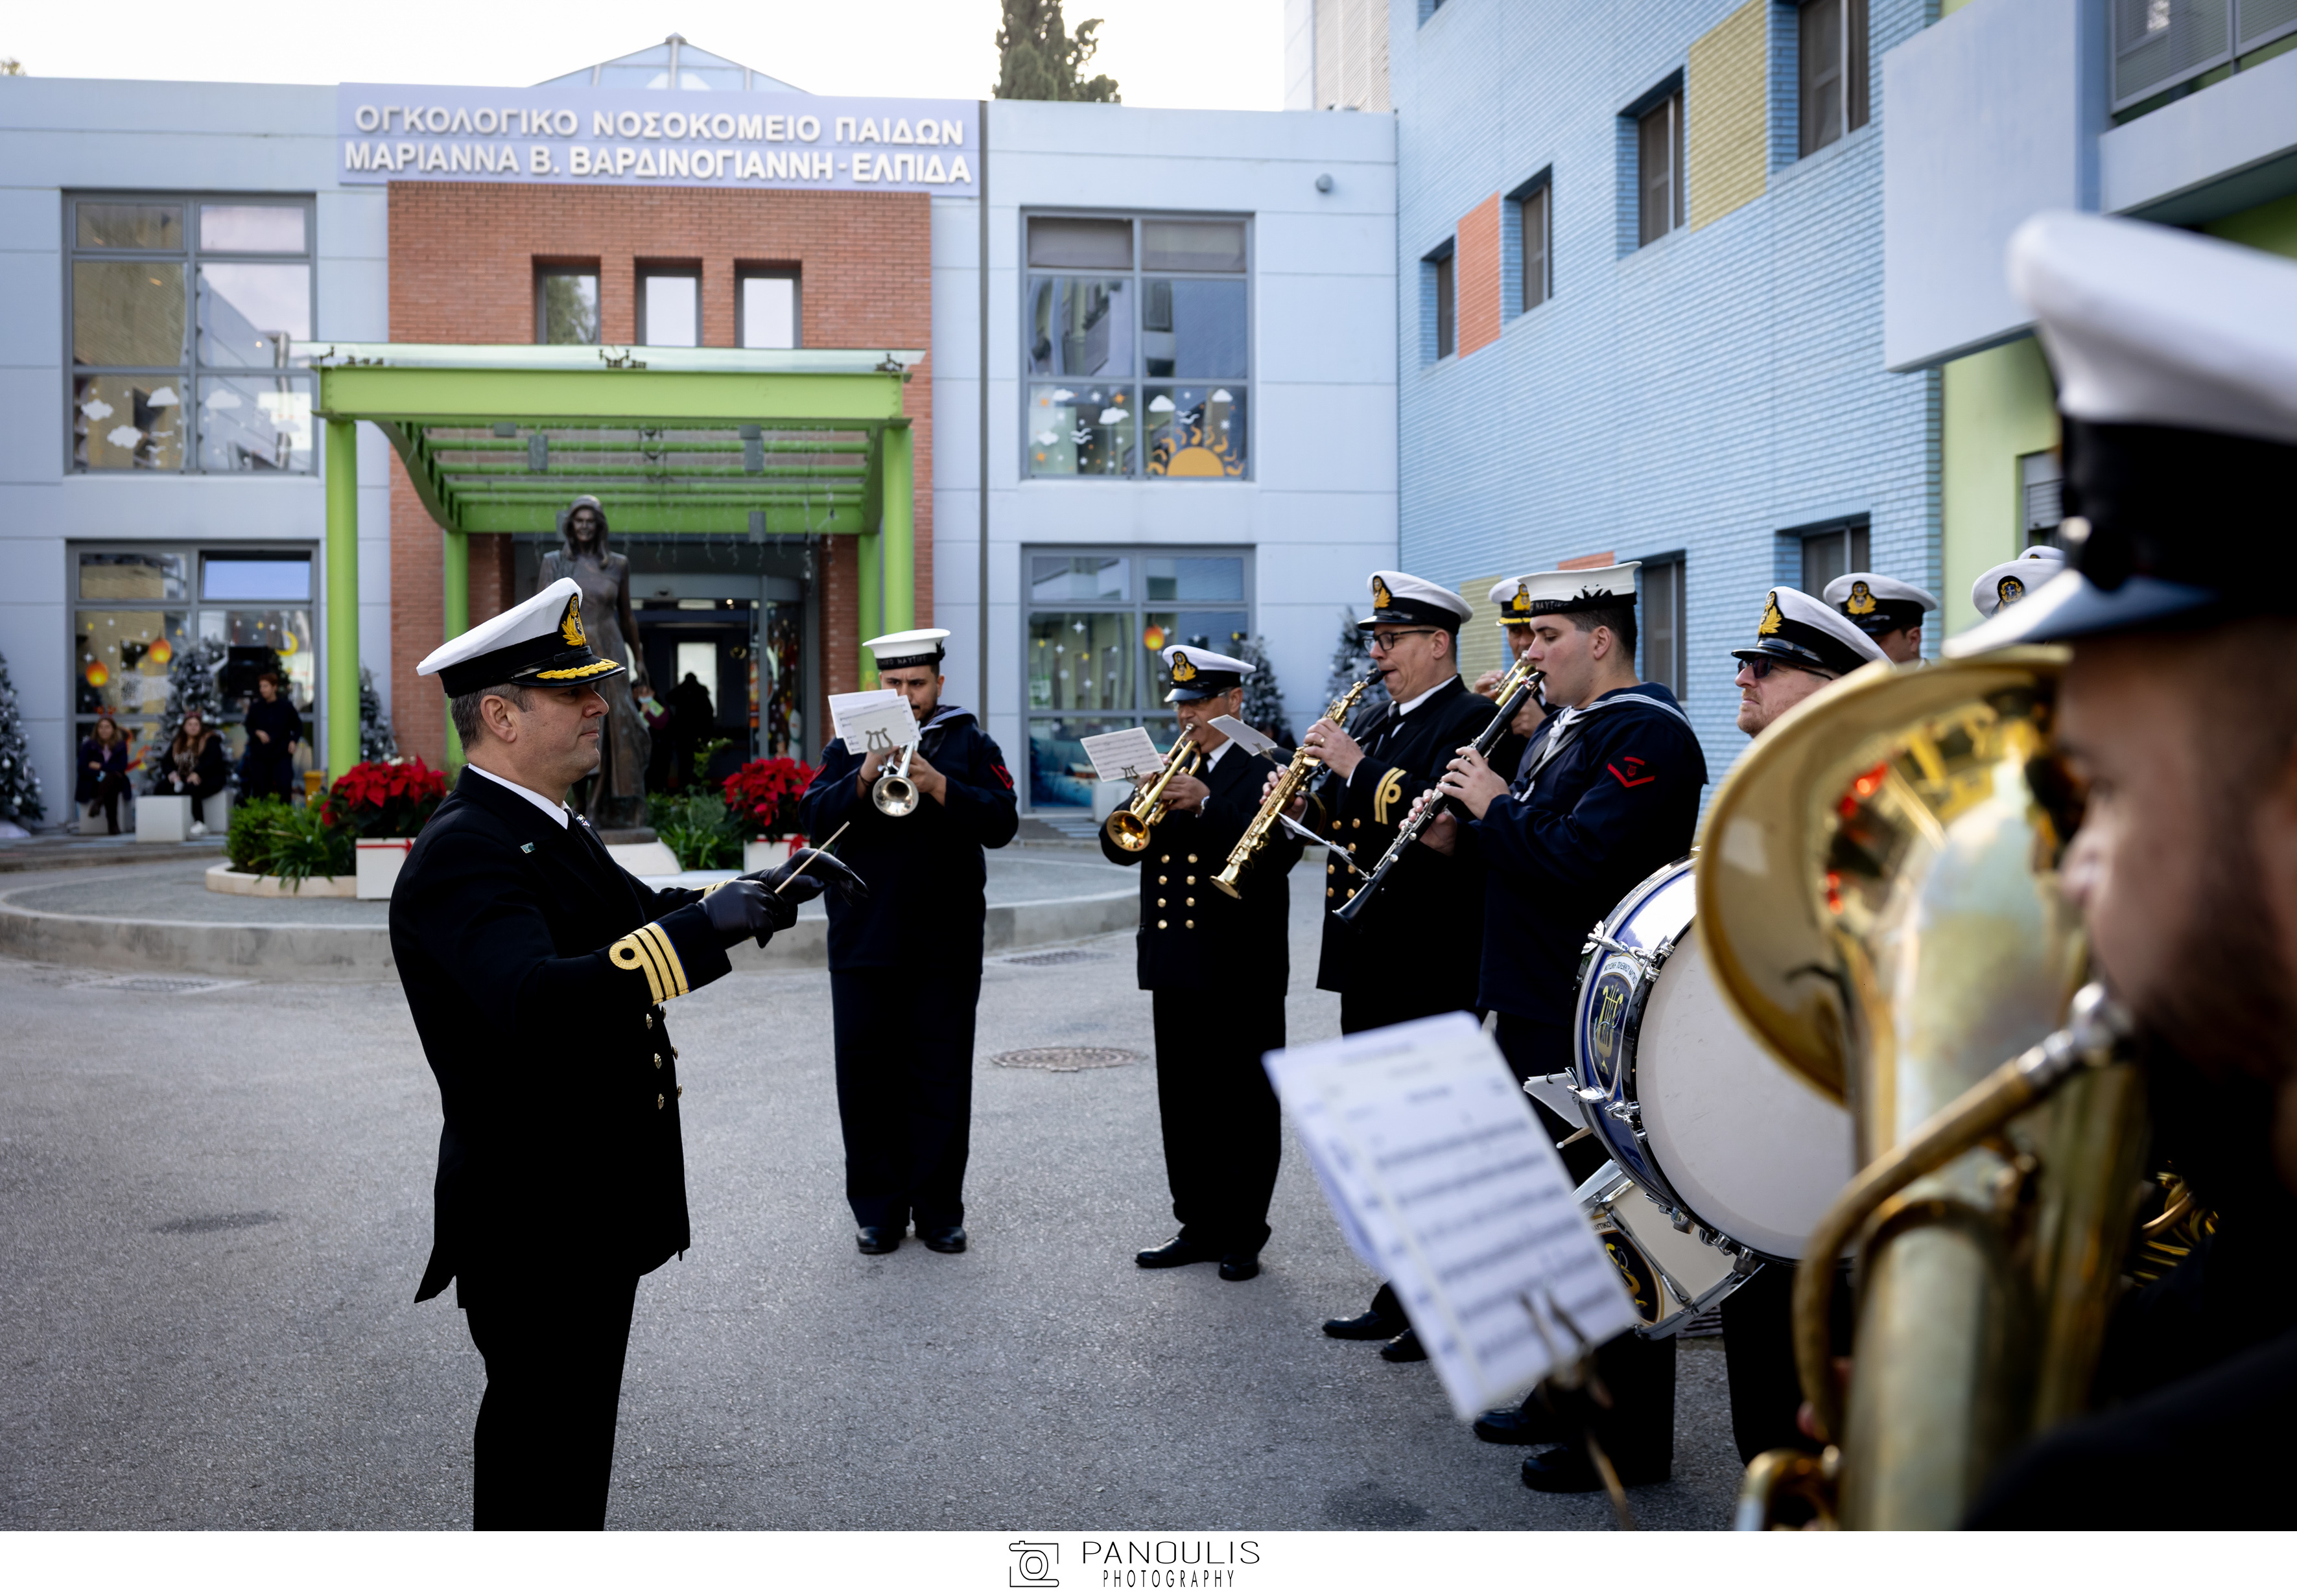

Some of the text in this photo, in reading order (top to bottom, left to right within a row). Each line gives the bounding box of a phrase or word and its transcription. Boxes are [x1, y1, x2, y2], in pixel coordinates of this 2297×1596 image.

[355, 104, 963, 147] ΟΓΚΟΛΟΓΙΚΟ ΝΟΣΟΚΟΜΕΙΟ ΠΑΙΔΩΝ
[345, 141, 520, 172] ΜΑΡΙΑΝΝΑ
[529, 145, 561, 174] Β.
